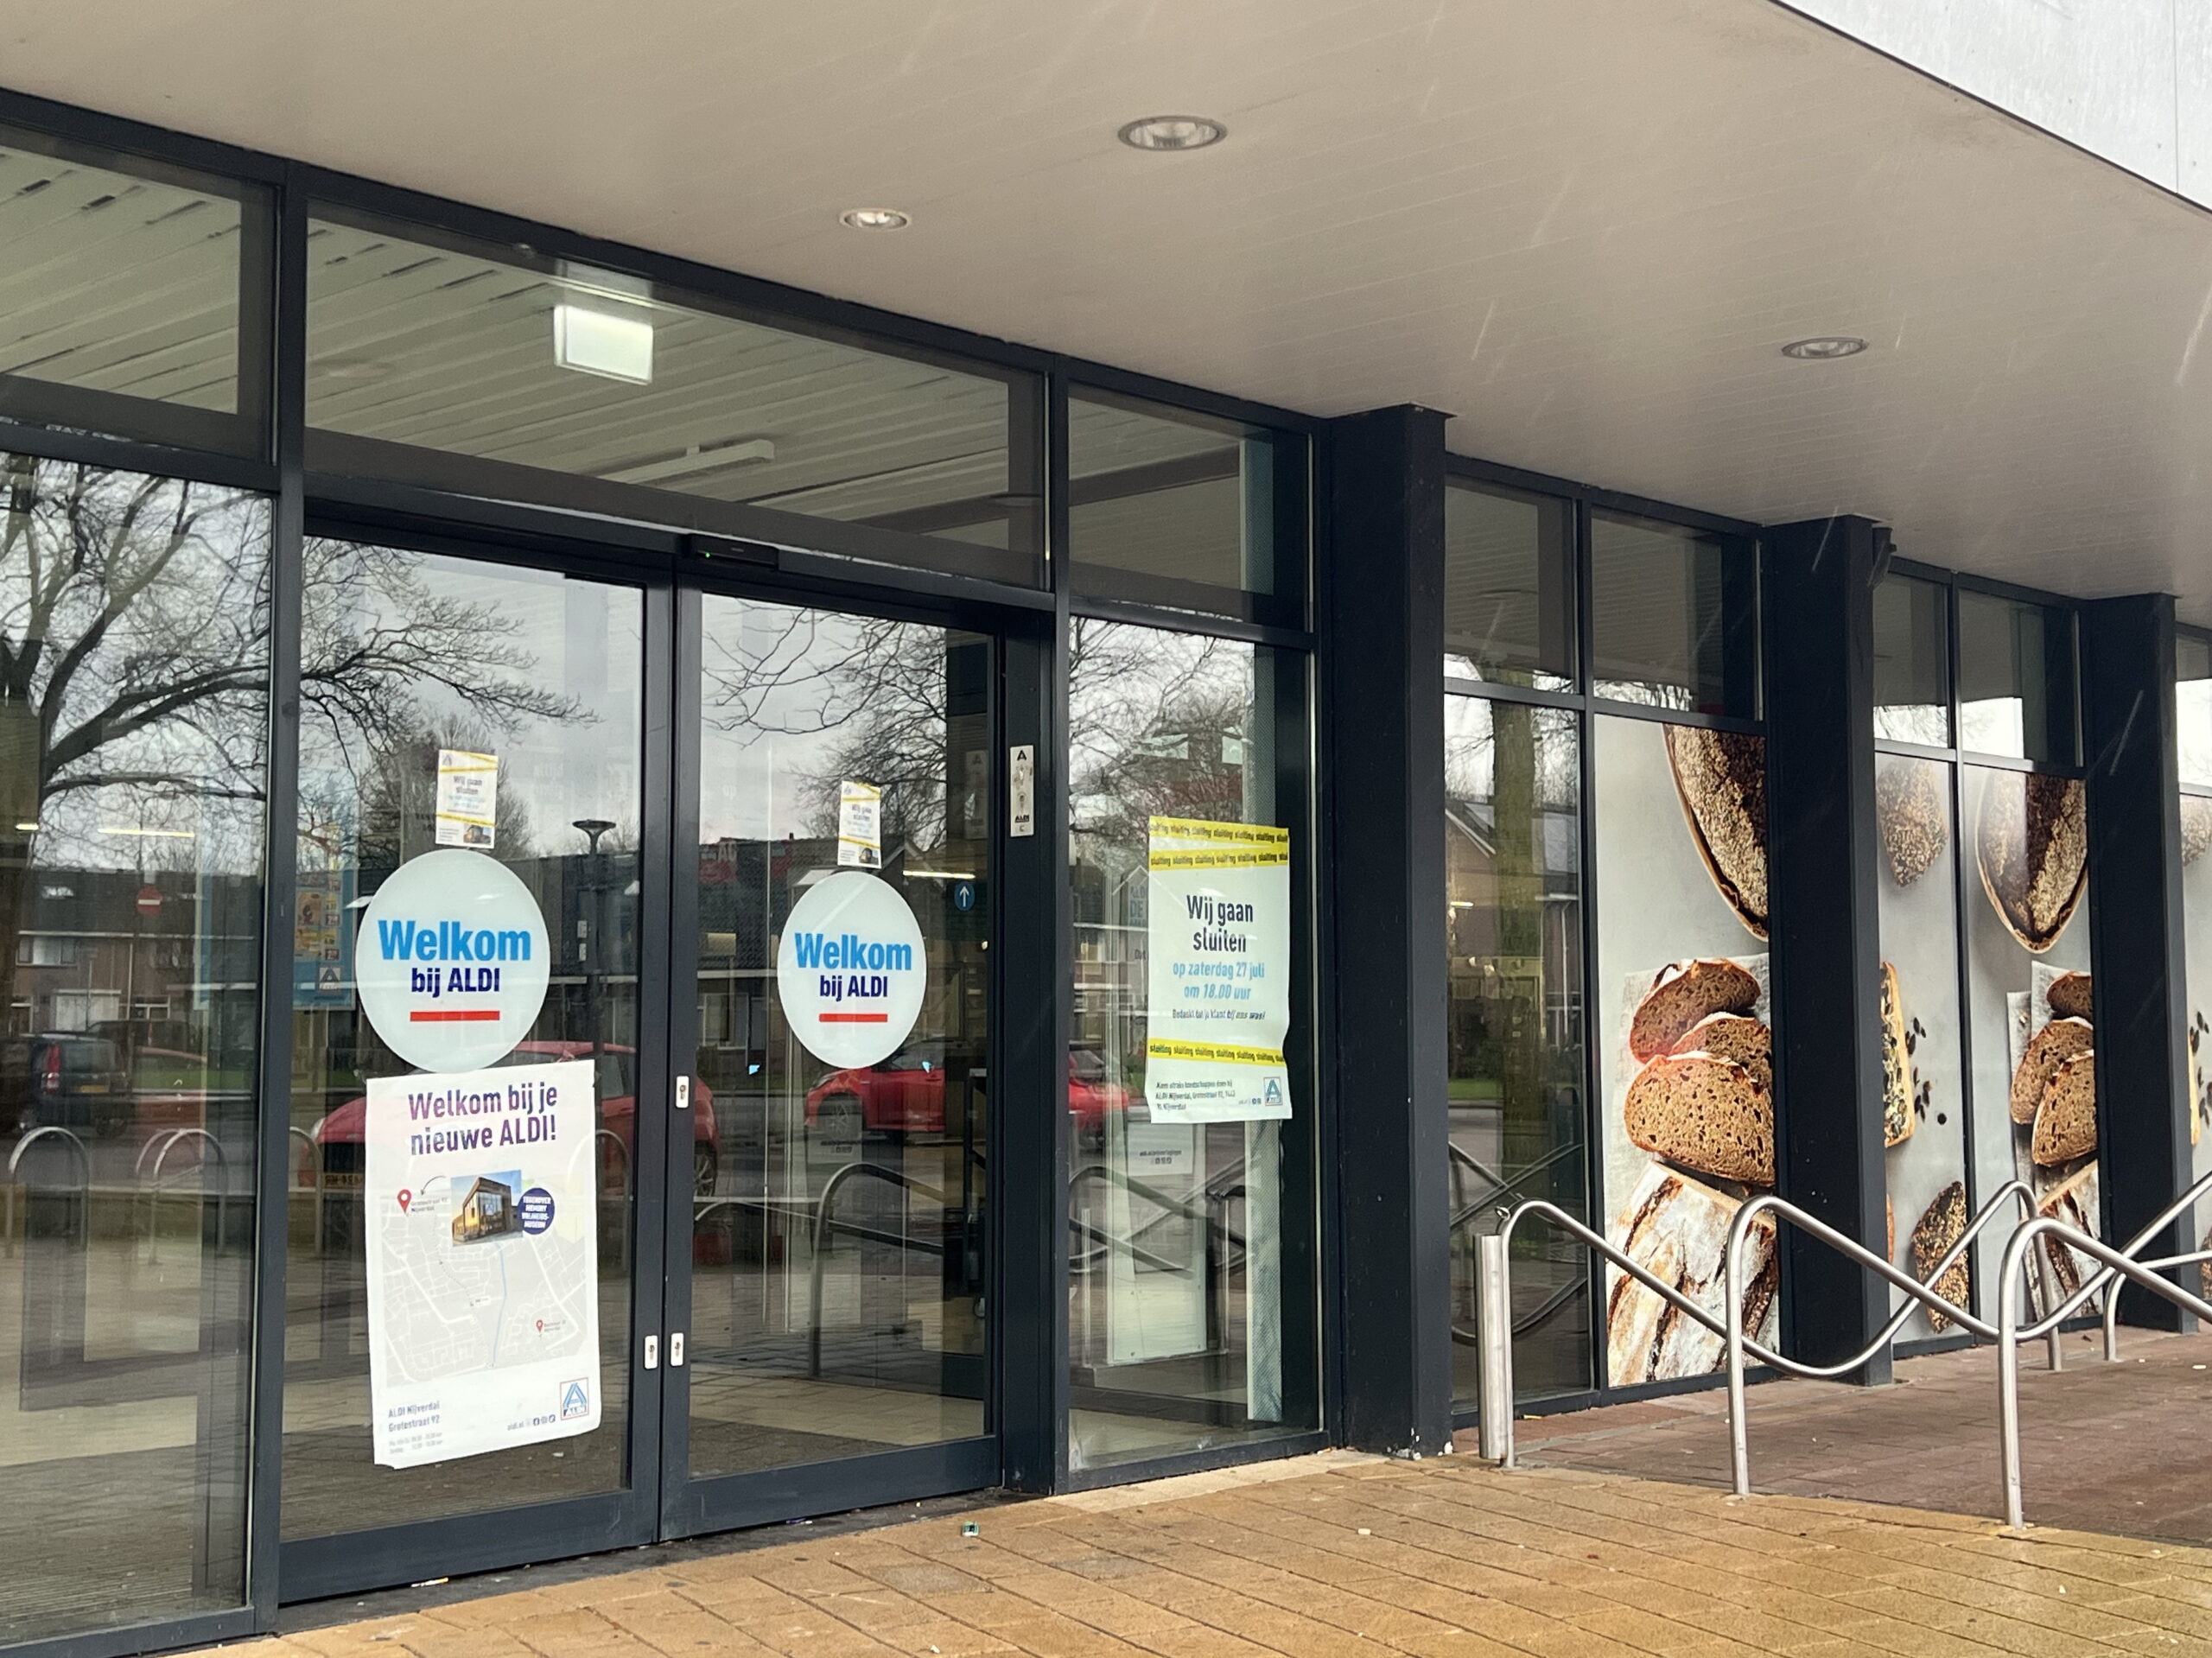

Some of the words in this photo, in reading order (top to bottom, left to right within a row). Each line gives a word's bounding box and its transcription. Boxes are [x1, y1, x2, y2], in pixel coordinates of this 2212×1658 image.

[1187, 895, 1213, 926] Wij
[1218, 902, 1253, 926] gaan
[378, 919, 531, 961] Welkom
[795, 932, 912, 971] Welkom
[1192, 927, 1246, 952] sluiten
[411, 968, 441, 997] bij
[448, 968, 500, 992] ALDI
[1173, 962, 1185, 978] op
[1188, 962, 1234, 980] zaterdag
[1236, 962, 1247, 977] 27
[1249, 962, 1265, 981] juli
[819, 975, 842, 1002] bij
[847, 975, 888, 997] ALDI
[1184, 985, 1199, 999] om
[1204, 983, 1232, 999] 18.00
[1234, 988, 1251, 1001] uur
[1211, 1009, 1225, 1019] klant
[1227, 1009, 1236, 1020] bij
[1249, 1011, 1265, 1020] was!
[408, 1089, 501, 1121] Welkom
[508, 1082, 534, 1115] bij
[539, 1082, 557, 1113] je
[411, 1127, 493, 1156] nieuwe
[499, 1115, 556, 1147] ALDI!
[389, 1407, 405, 1418] ALDI
[407, 1401, 440, 1415] Nijverdal
[389, 1417, 430, 1432] Grotestraat
[430, 1414, 441, 1424] 92
